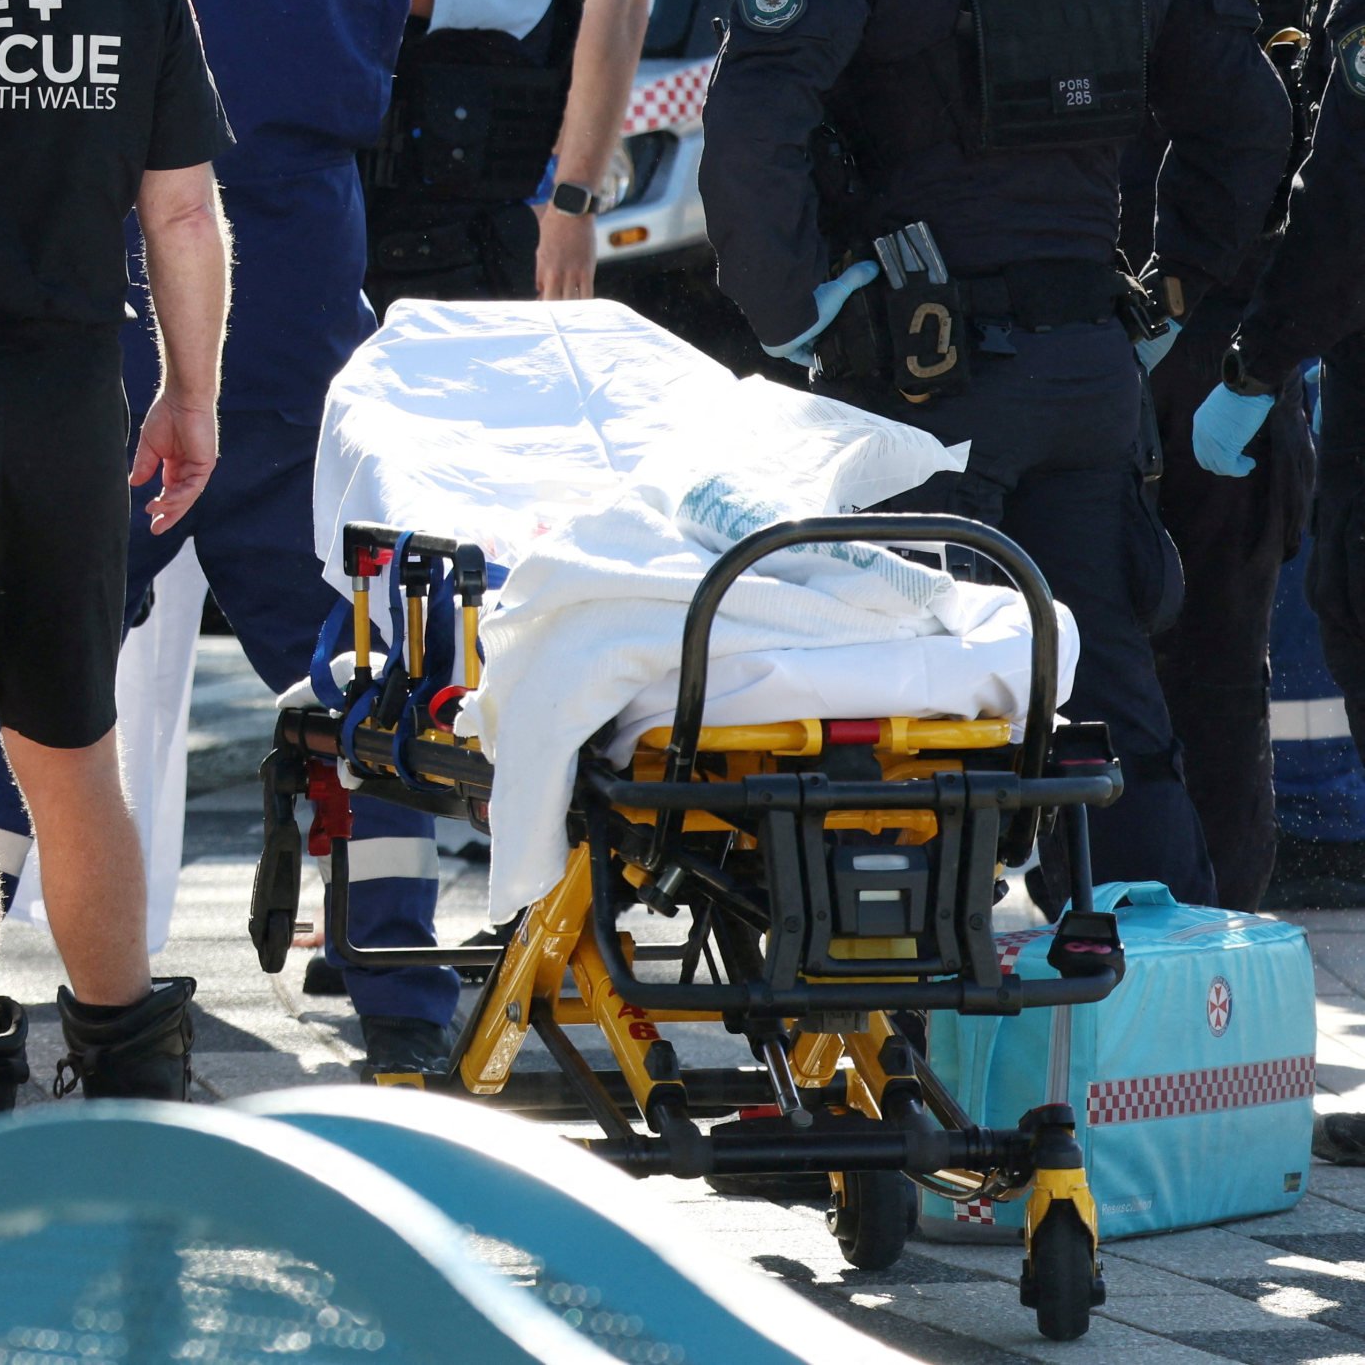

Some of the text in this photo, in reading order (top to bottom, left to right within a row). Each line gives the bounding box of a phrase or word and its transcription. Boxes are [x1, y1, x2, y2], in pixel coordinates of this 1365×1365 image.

[1059, 78, 1090, 91] PORS
[37, 86, 116, 110] WALES
[1066, 90, 1092, 105] 285
